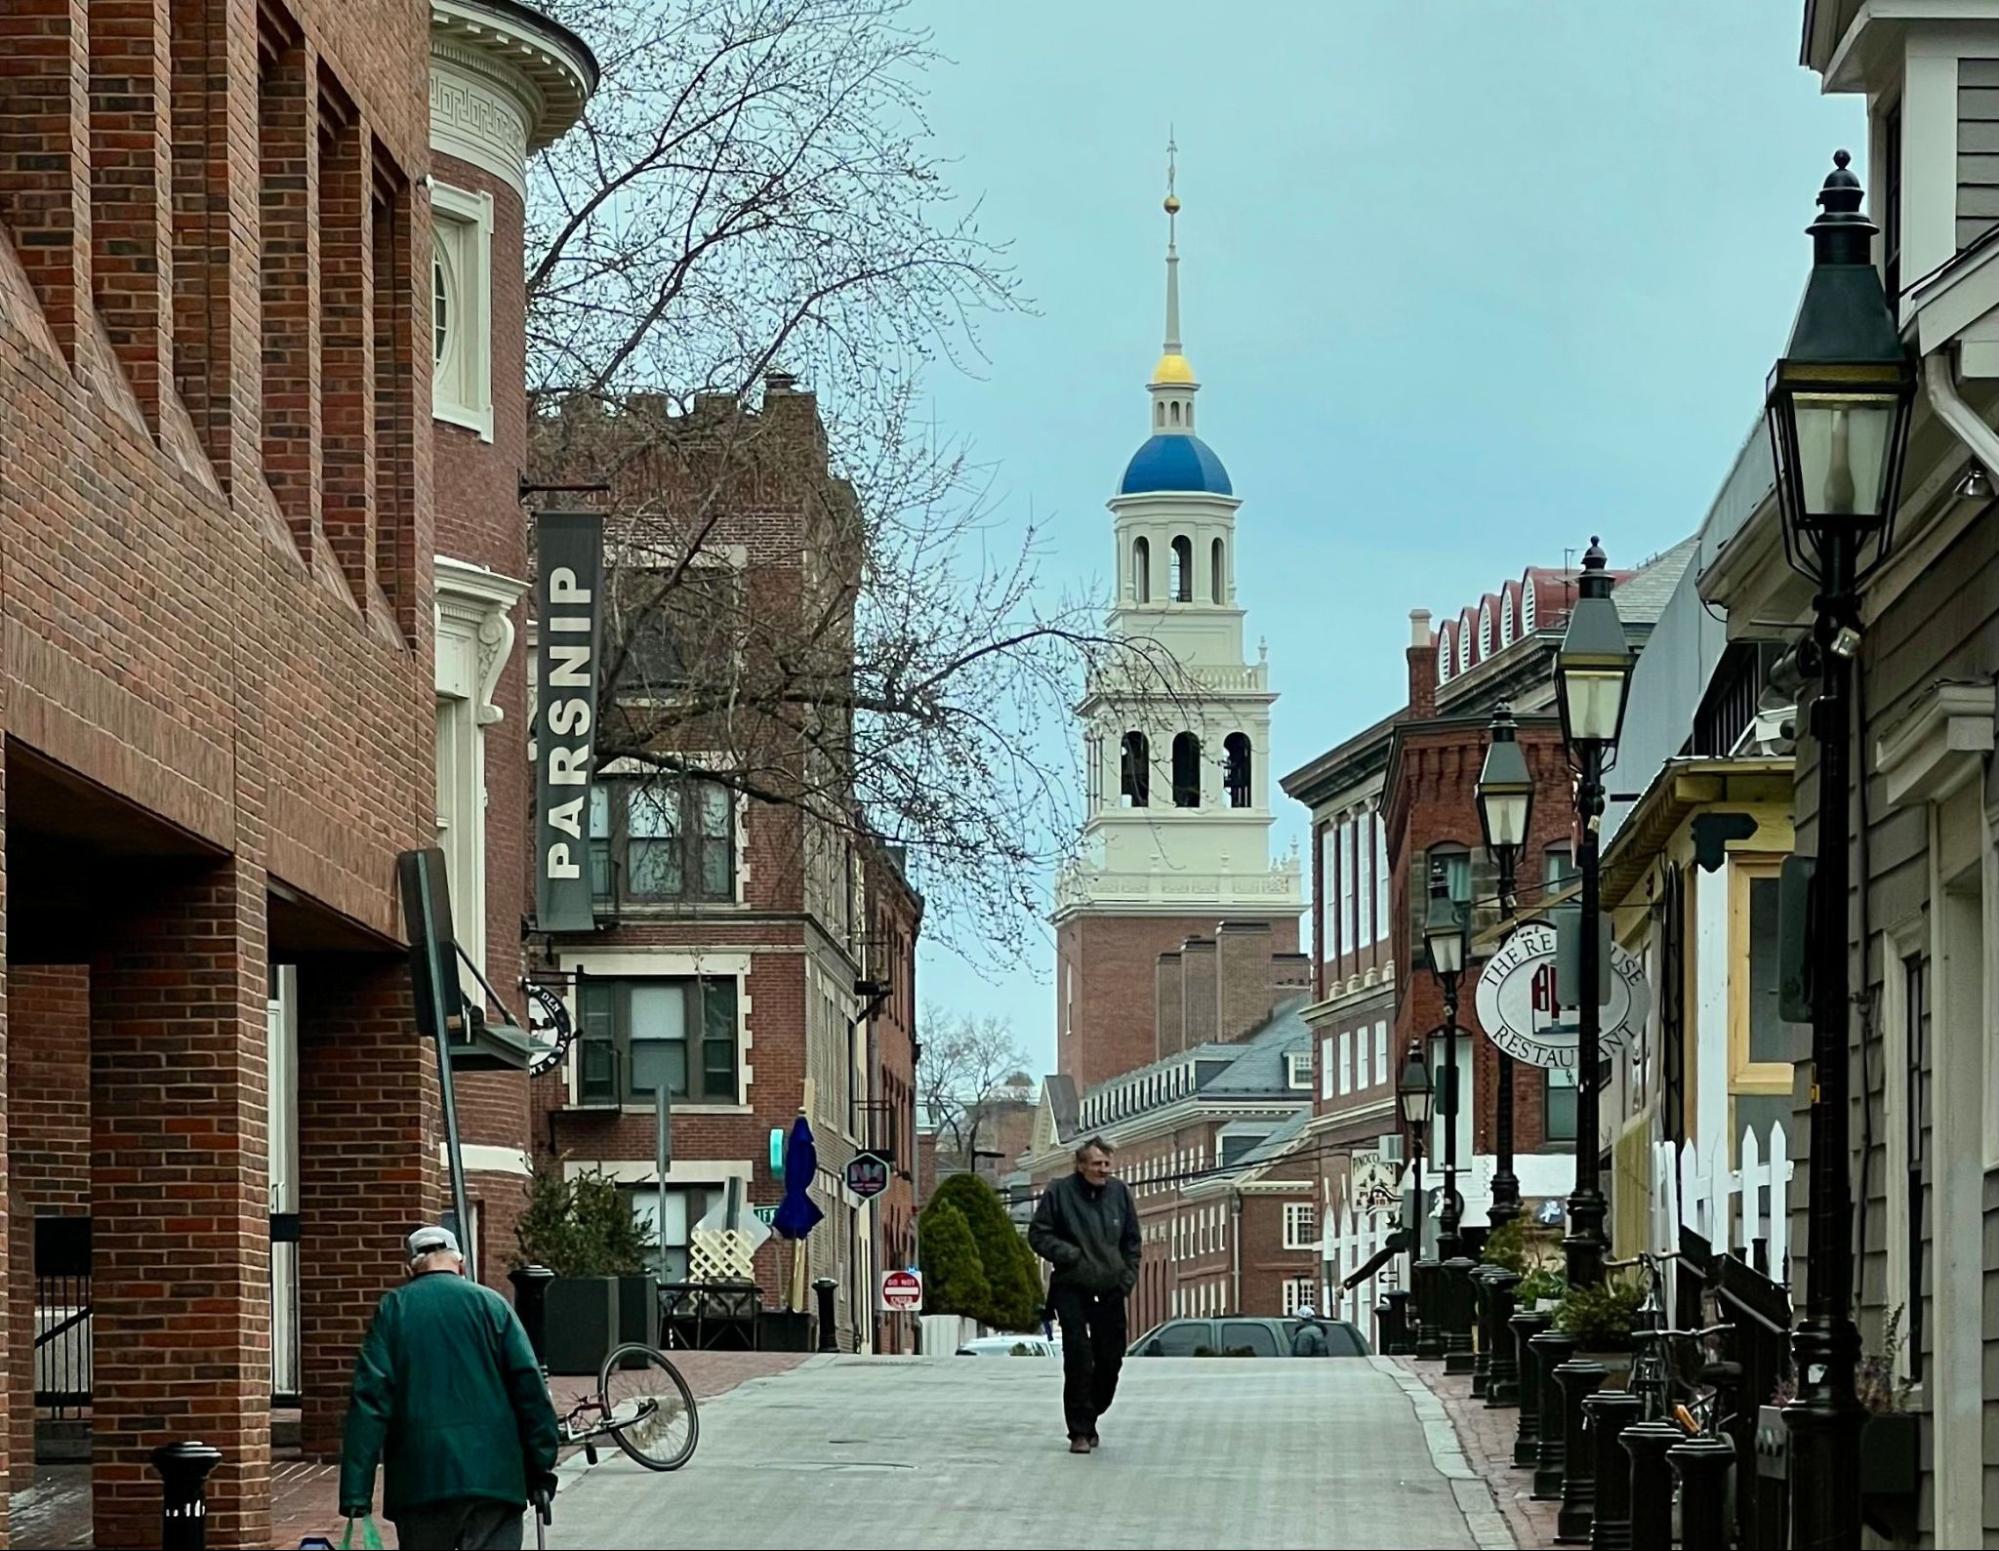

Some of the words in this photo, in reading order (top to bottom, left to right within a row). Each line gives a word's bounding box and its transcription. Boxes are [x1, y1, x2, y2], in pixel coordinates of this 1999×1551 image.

[548, 566, 592, 879] PARSNIP
[1481, 947, 1523, 987] THE
[1522, 932, 1554, 957] RE
[1610, 946, 1643, 987] USE
[541, 992, 561, 1012] DEN
[1493, 1020, 1635, 1068] RESTAUNT
